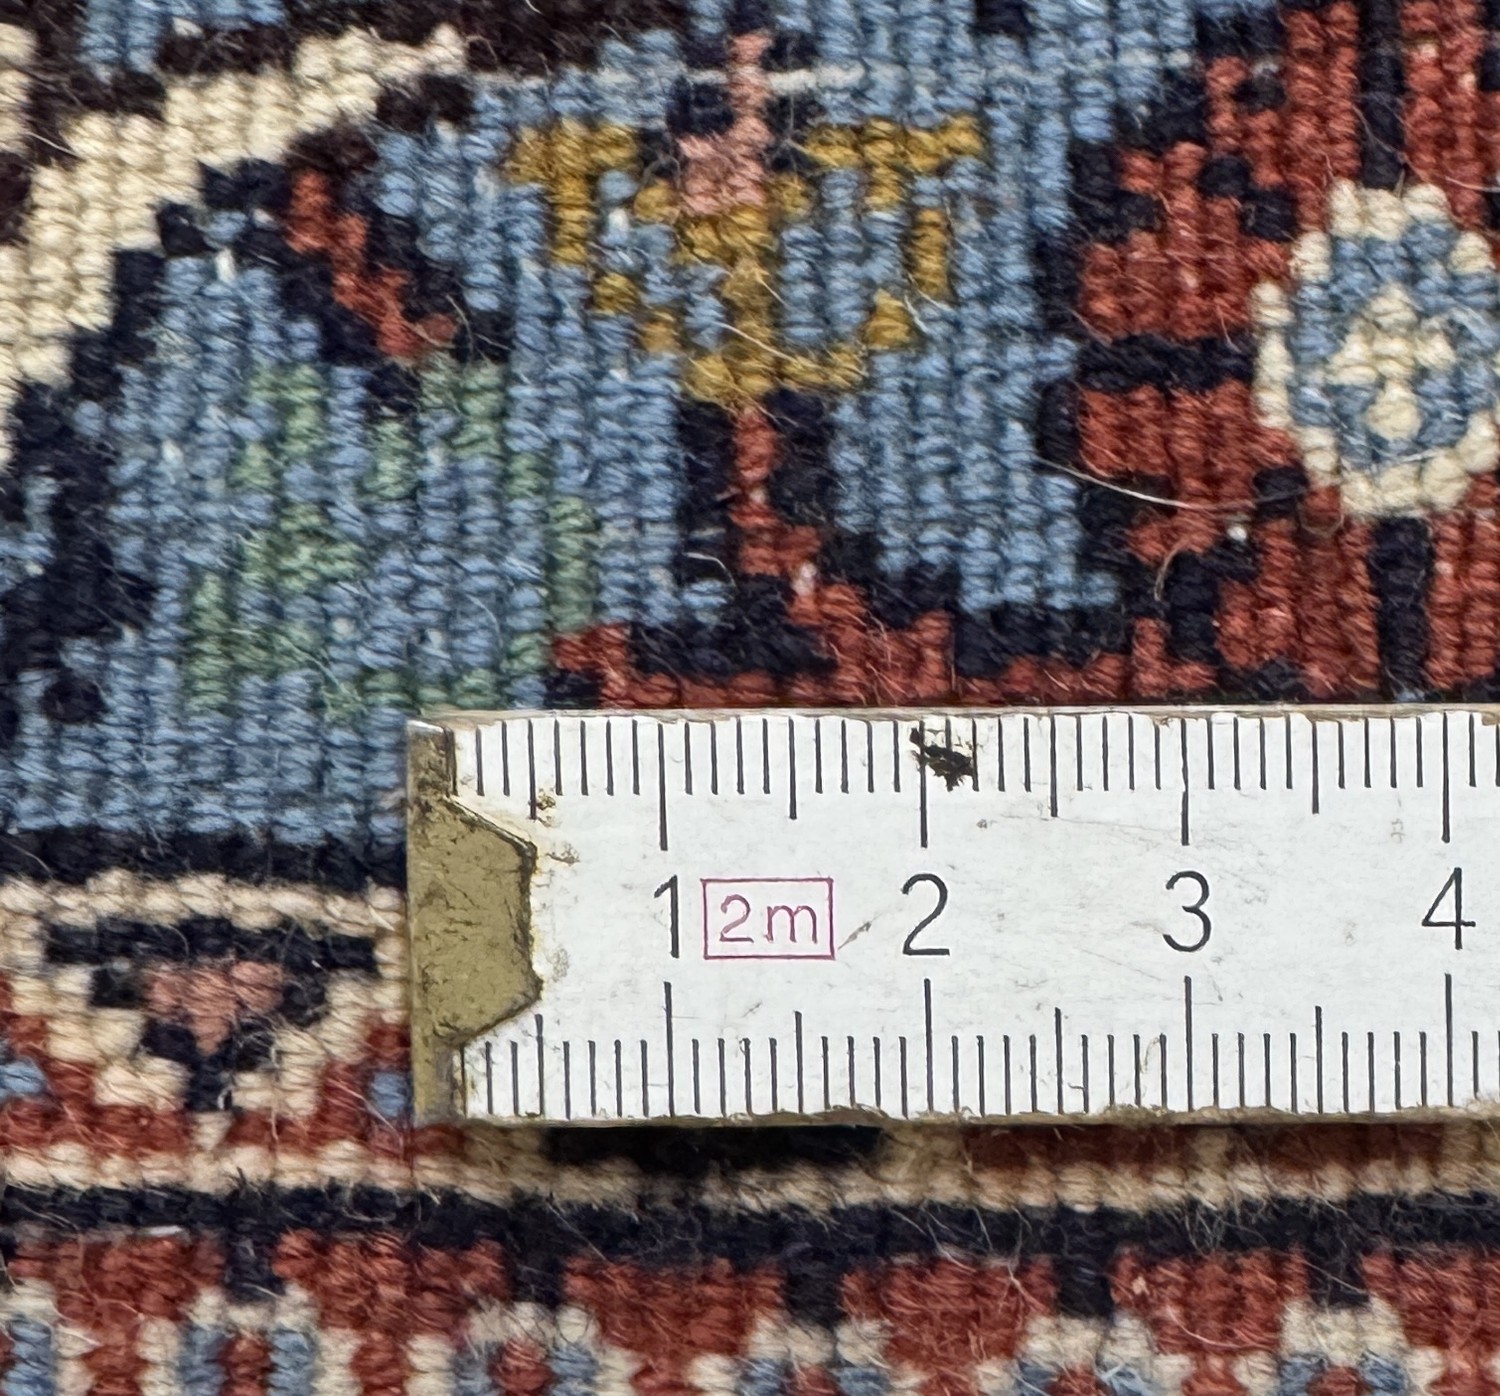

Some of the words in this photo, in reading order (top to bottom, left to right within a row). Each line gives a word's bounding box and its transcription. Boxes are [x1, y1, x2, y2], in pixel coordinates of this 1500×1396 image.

[653, 875, 680, 959] 1
[719, 894, 820, 944] 2m
[901, 873, 951, 956] 2
[1162, 870, 1212, 953] 3
[1421, 866, 1477, 951] 4
